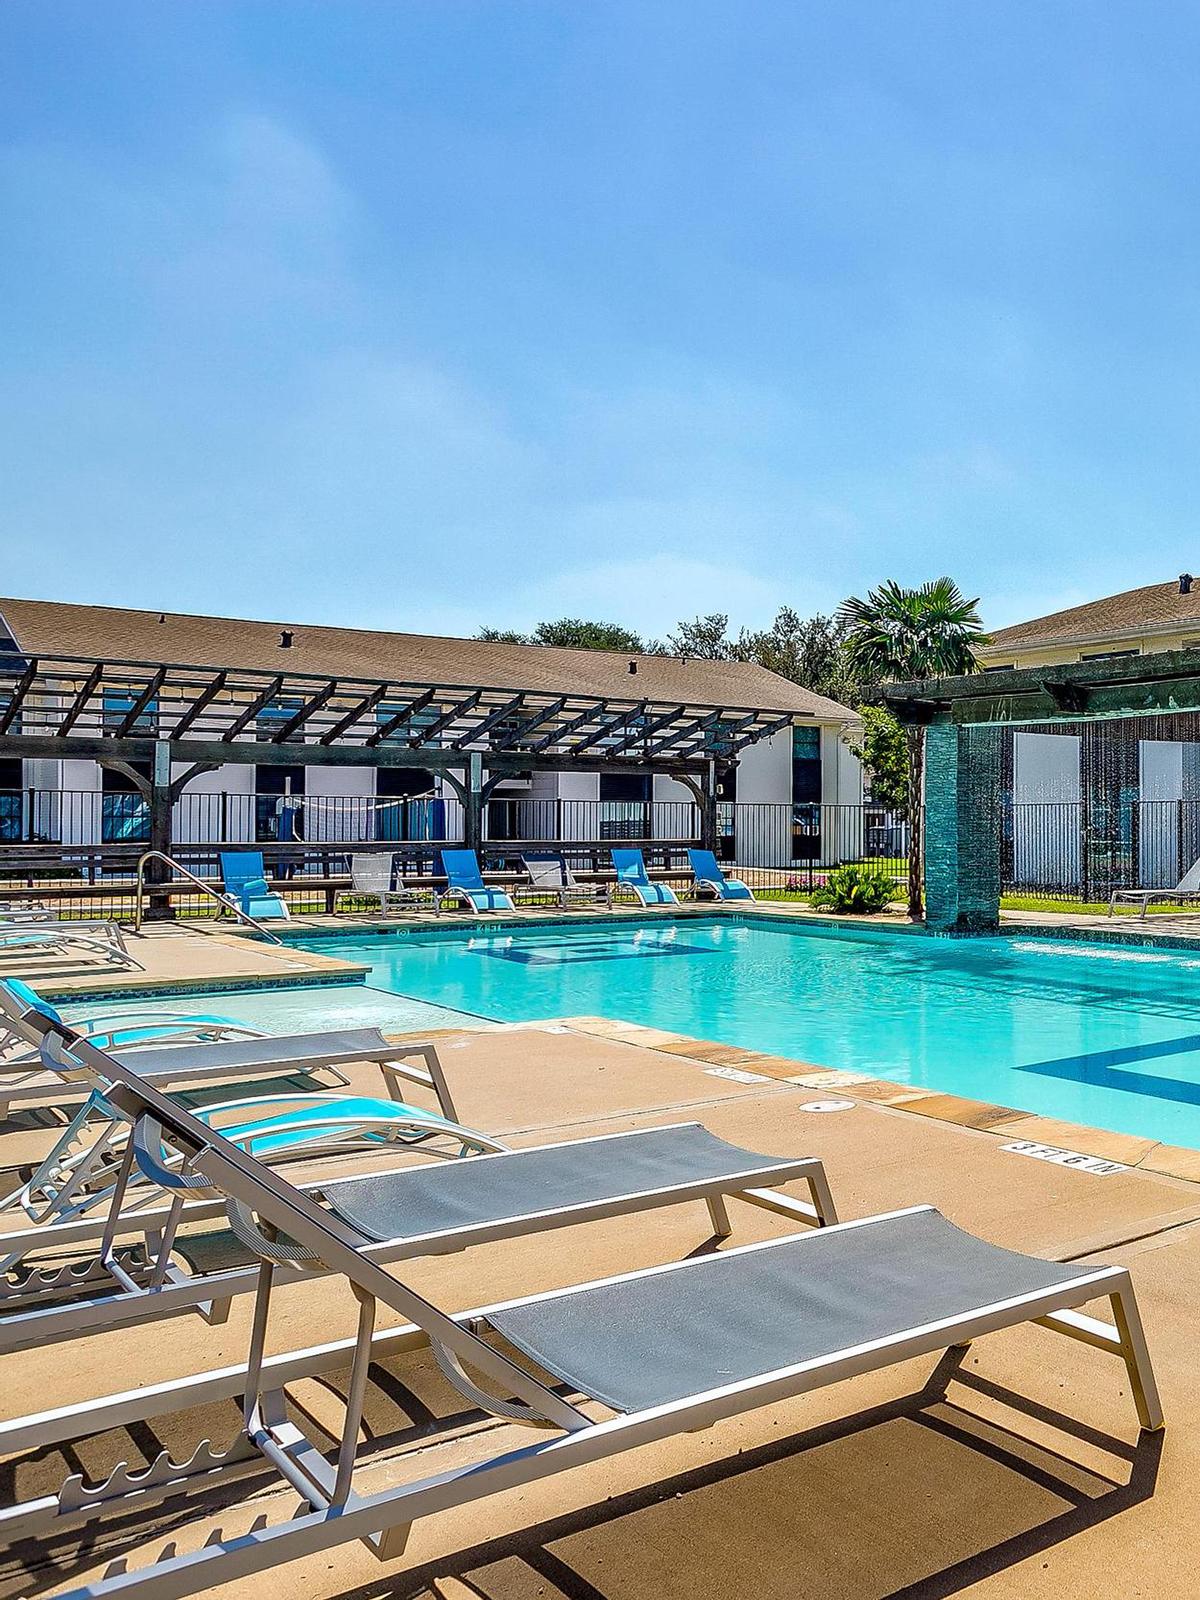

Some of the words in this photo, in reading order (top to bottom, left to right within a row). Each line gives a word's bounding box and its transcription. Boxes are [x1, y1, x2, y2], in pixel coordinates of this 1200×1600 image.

[1011, 1143, 1036, 1151] 3
[1030, 1148, 1068, 1158] FT
[1063, 1156, 1088, 1165] 6
[1085, 1162, 1123, 1173] IN
